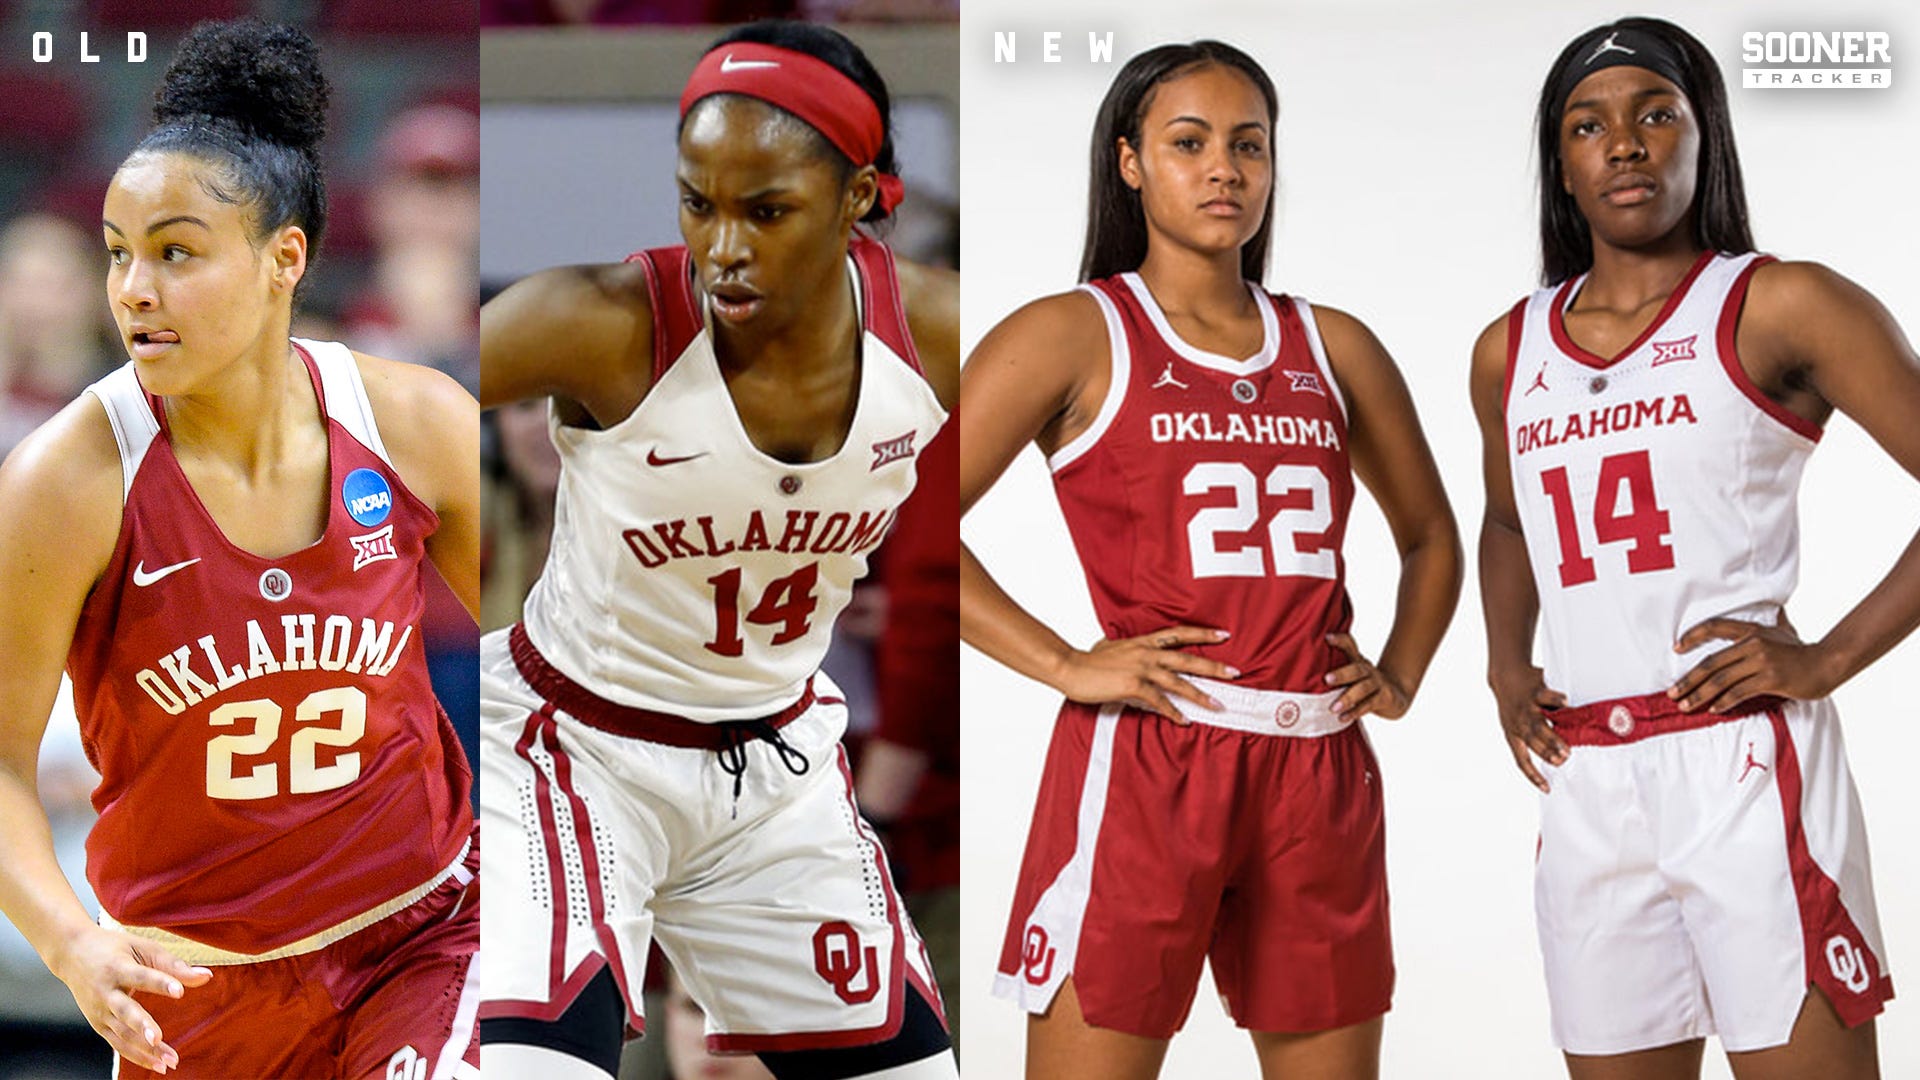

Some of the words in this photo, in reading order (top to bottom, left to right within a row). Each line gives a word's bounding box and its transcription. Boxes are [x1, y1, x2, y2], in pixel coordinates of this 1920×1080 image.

[1151, 412, 1341, 452] OKLAHOMA
[1517, 394, 1698, 455] OKLAHOMA
[351, 491, 391, 516] NCAA
[1182, 462, 1337, 579] 22
[1540, 449, 1675, 588] 14
[703, 561, 819, 658] 14
[206, 686, 367, 801] 22
[812, 920, 881, 1007] OU
[1024, 923, 1057, 987] OU
[1825, 934, 1870, 994] OU
